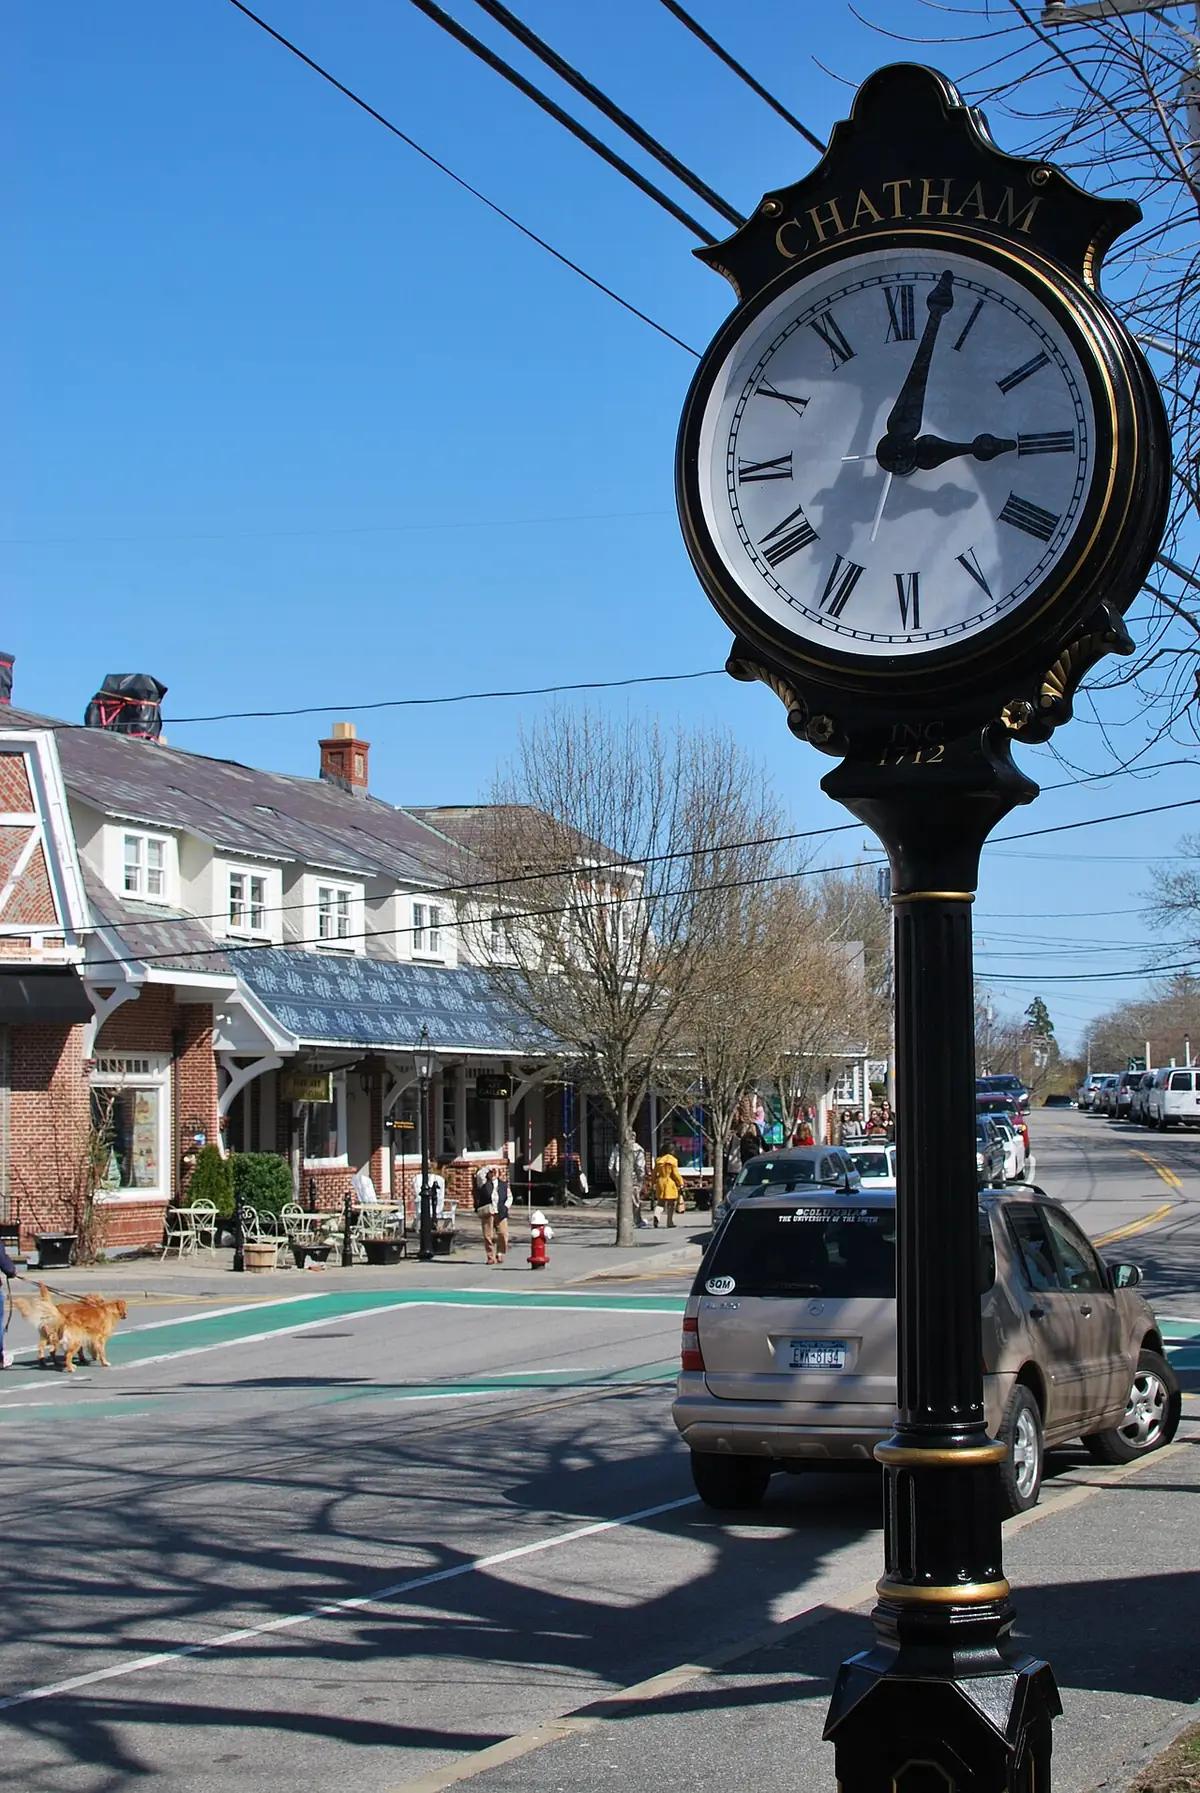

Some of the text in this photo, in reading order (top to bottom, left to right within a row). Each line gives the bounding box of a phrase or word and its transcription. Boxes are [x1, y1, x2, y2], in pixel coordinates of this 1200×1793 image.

[775, 178, 1044, 259] CHATHAM
[806, 308, 858, 371] XI
[882, 284, 917, 343] XII
[951, 297, 987, 352] I
[754, 375, 811, 417] X
[995, 348, 1053, 395] II
[738, 450, 794, 487] IX
[1016, 428, 1075, 460] III
[757, 504, 821, 570] VIII
[818, 553, 867, 619] VII
[954, 546, 994, 600] V
[893, 571, 922, 631] VI
[876, 744, 945, 766] 1712
[778, 1215, 791, 1223] THE
[793, 1215, 831, 1223] UNIVERSITY
[842, 1215, 855, 1223] THE
